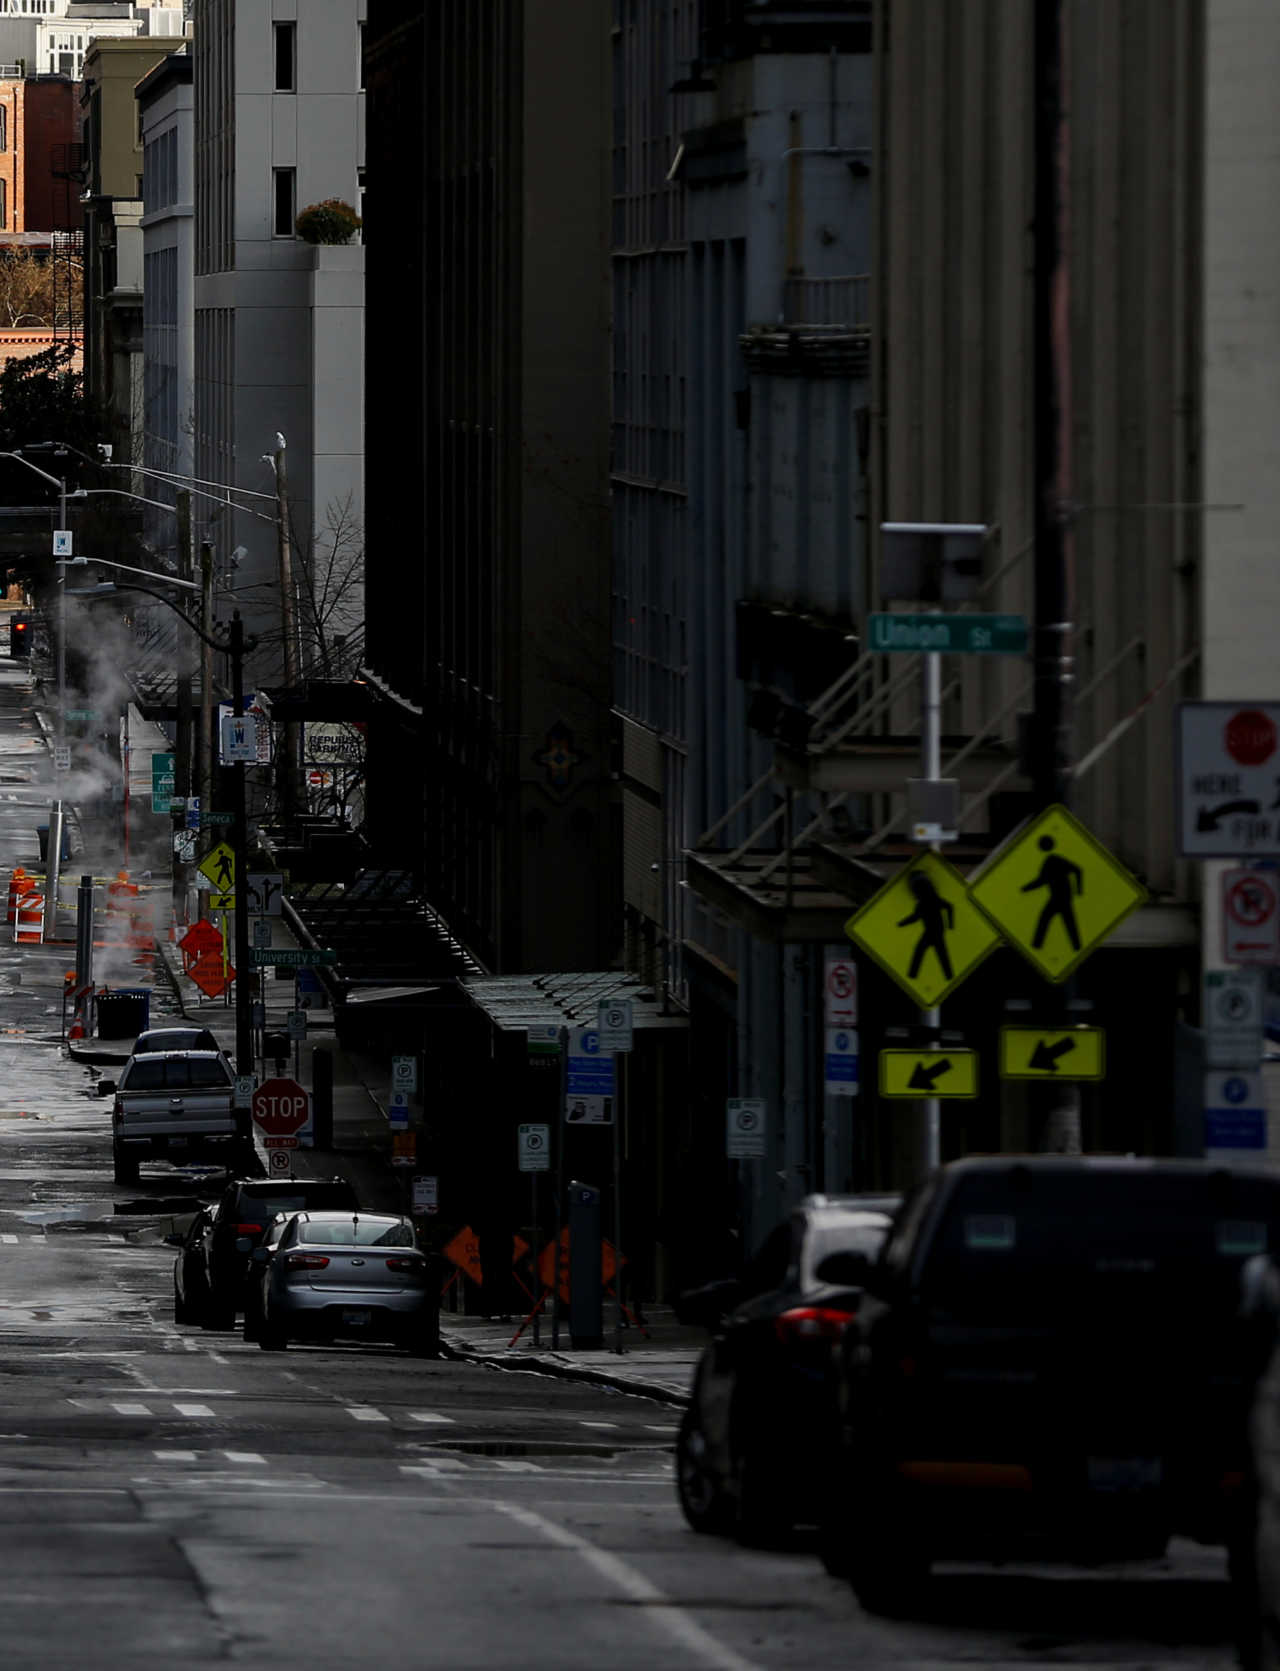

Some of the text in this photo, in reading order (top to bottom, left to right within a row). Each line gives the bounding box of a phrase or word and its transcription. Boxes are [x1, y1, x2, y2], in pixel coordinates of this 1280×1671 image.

[874, 618, 991, 648] Union St
[1229, 729, 1273, 751] STOP
[1193, 775, 1241, 794] HERE
[254, 950, 309, 965] University
[255, 1096, 305, 1119] STOP
